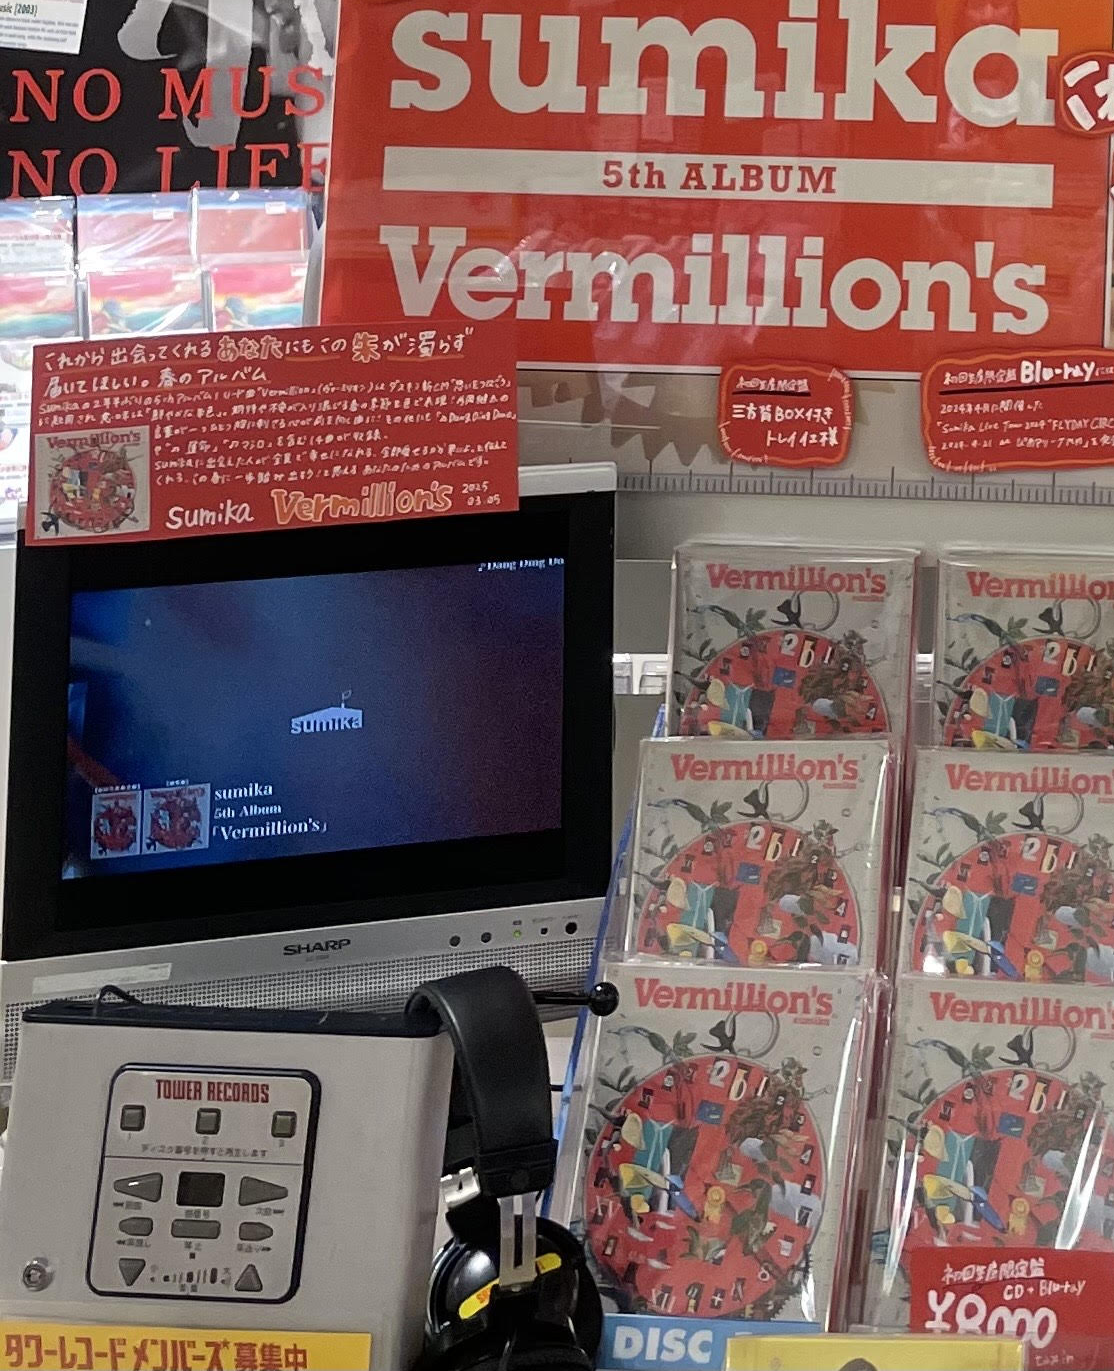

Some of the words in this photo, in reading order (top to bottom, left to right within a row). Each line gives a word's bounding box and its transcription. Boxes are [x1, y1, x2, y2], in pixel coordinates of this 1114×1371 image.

[9, 69, 121, 122] NO
[7, 148, 117, 198] NO
[602, 162, 665, 190] 5th
[682, 163, 837, 194] ALBUM
[379, 225, 1050, 336] Vermillion's
[271, 481, 453, 524] Vermillion's
[706, 564, 887, 595] Vermillion's
[671, 754, 858, 783] Vermillion's
[214, 782, 273, 801] sumika
[214, 807, 235, 820] 5th
[239, 803, 282, 817] Album
[282, 938, 350, 956] SHARP
[634, 978, 833, 1017] Vermillion's
[156, 1079, 202, 1101] TOWER
[207, 1082, 270, 1103] RECORDS
[1003, 1284, 1024, 1301] CD
[612, 1326, 712, 1363] DISC
